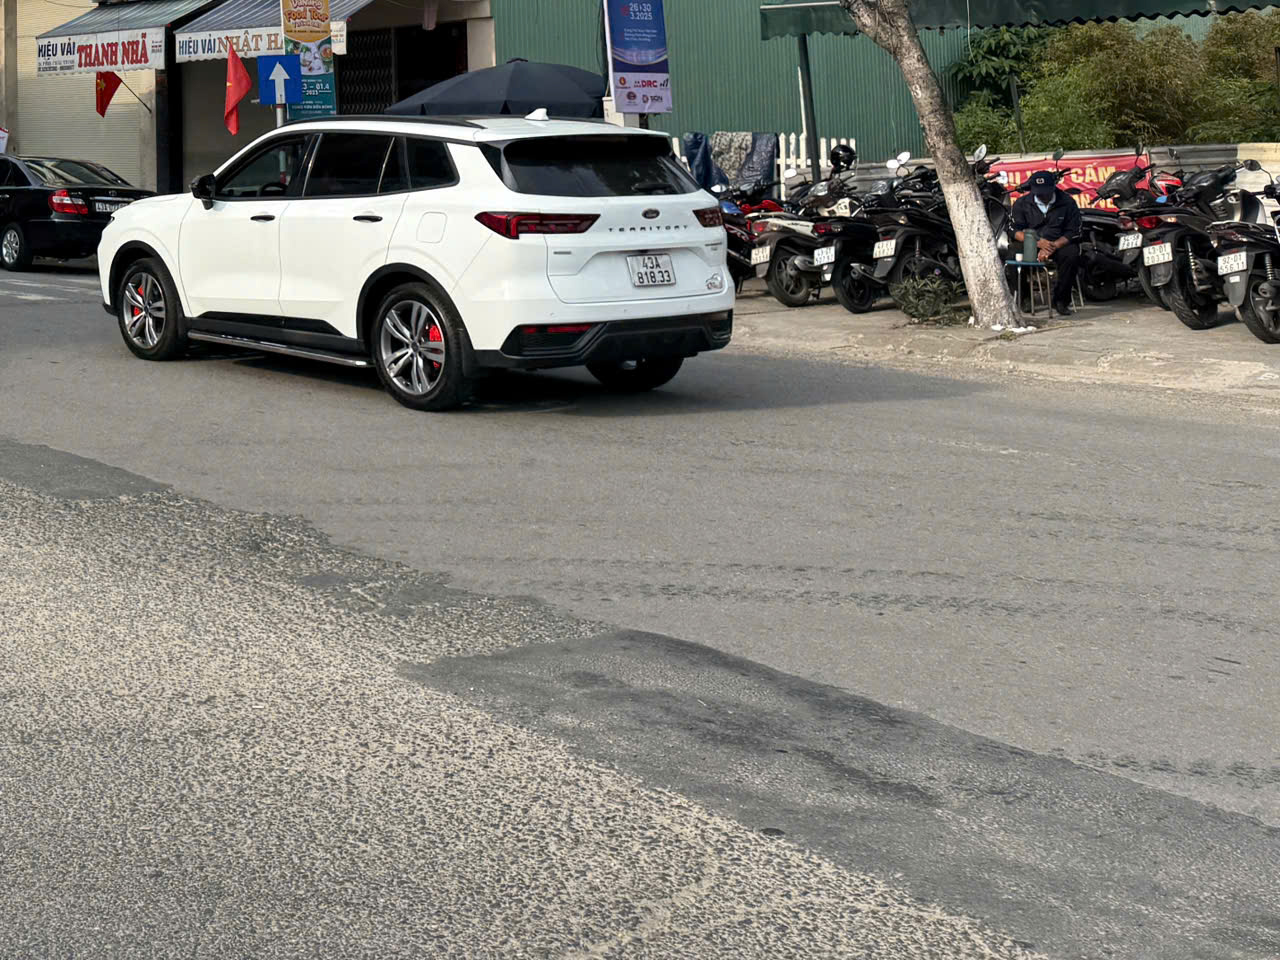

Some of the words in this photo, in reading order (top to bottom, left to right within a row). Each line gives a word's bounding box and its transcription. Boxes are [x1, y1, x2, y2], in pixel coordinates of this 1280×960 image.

[60, 37, 76, 56] VẢI
[77, 41, 119, 68] THANH
[121, 32, 149, 65] NHÃ
[178, 36, 199, 58] HIỆU
[202, 33, 216, 55] VẢI
[217, 30, 263, 57] NHẬT
[608, 224, 688, 232] TERRITORY
[642, 256, 661, 270] 43A
[637, 270, 672, 284] 818.33
